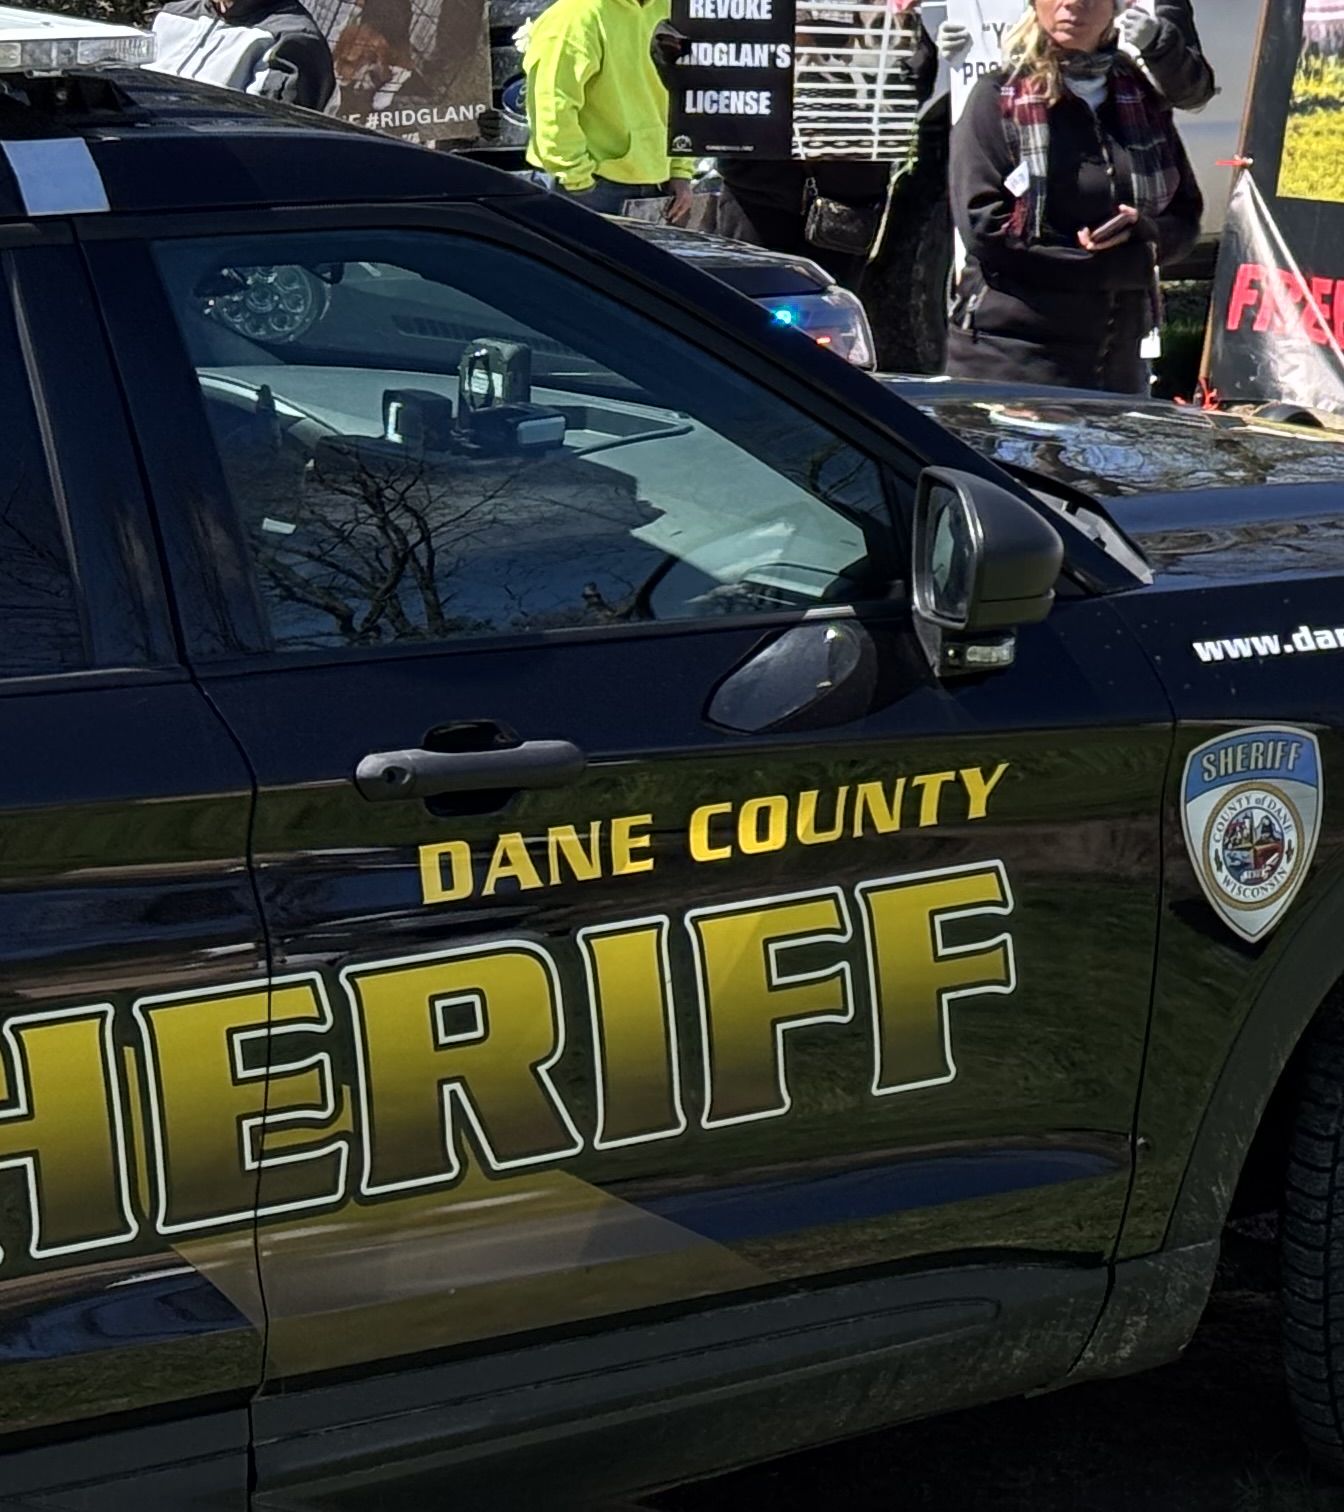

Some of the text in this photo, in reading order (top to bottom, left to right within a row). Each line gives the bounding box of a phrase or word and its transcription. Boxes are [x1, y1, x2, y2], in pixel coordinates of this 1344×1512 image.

[685, 90, 772, 116] LICENSE
[1202, 740, 1303, 782] SHERIFF
[419, 763, 1010, 905] DANE COUNTY
[1213, 794, 1294, 844] COUNTY of DANE
[1222, 868, 1288, 898] WISCONSIN
[0, 860, 1014, 1258] HERIFF
